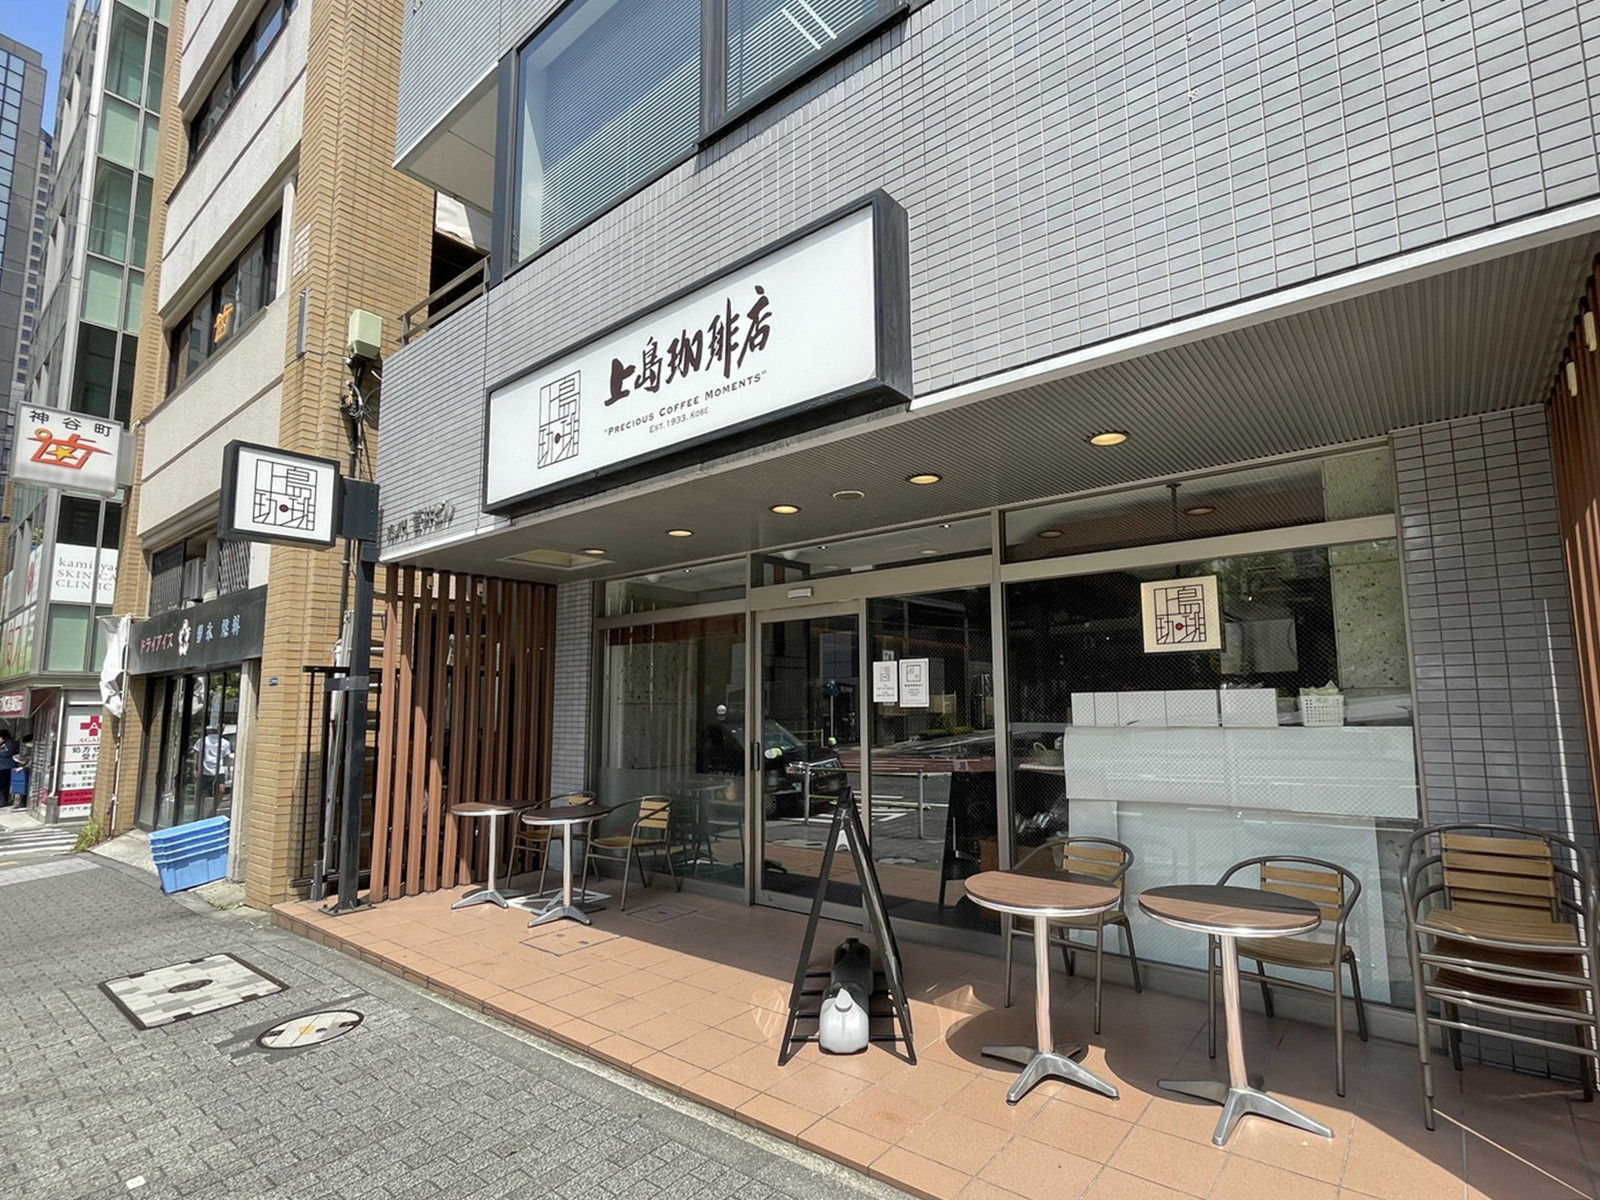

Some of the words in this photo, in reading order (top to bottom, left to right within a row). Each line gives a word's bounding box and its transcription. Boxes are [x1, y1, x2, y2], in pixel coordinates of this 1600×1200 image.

[604, 285, 772, 407] 上島珈琲店
[658, 396, 700, 417] COFFEE
[29, 410, 112, 437] 神谷町
[57, 569, 92, 579] SKIN
[59, 557, 117, 572] kamiya
[140, 632, 174, 655] ドライアイス
